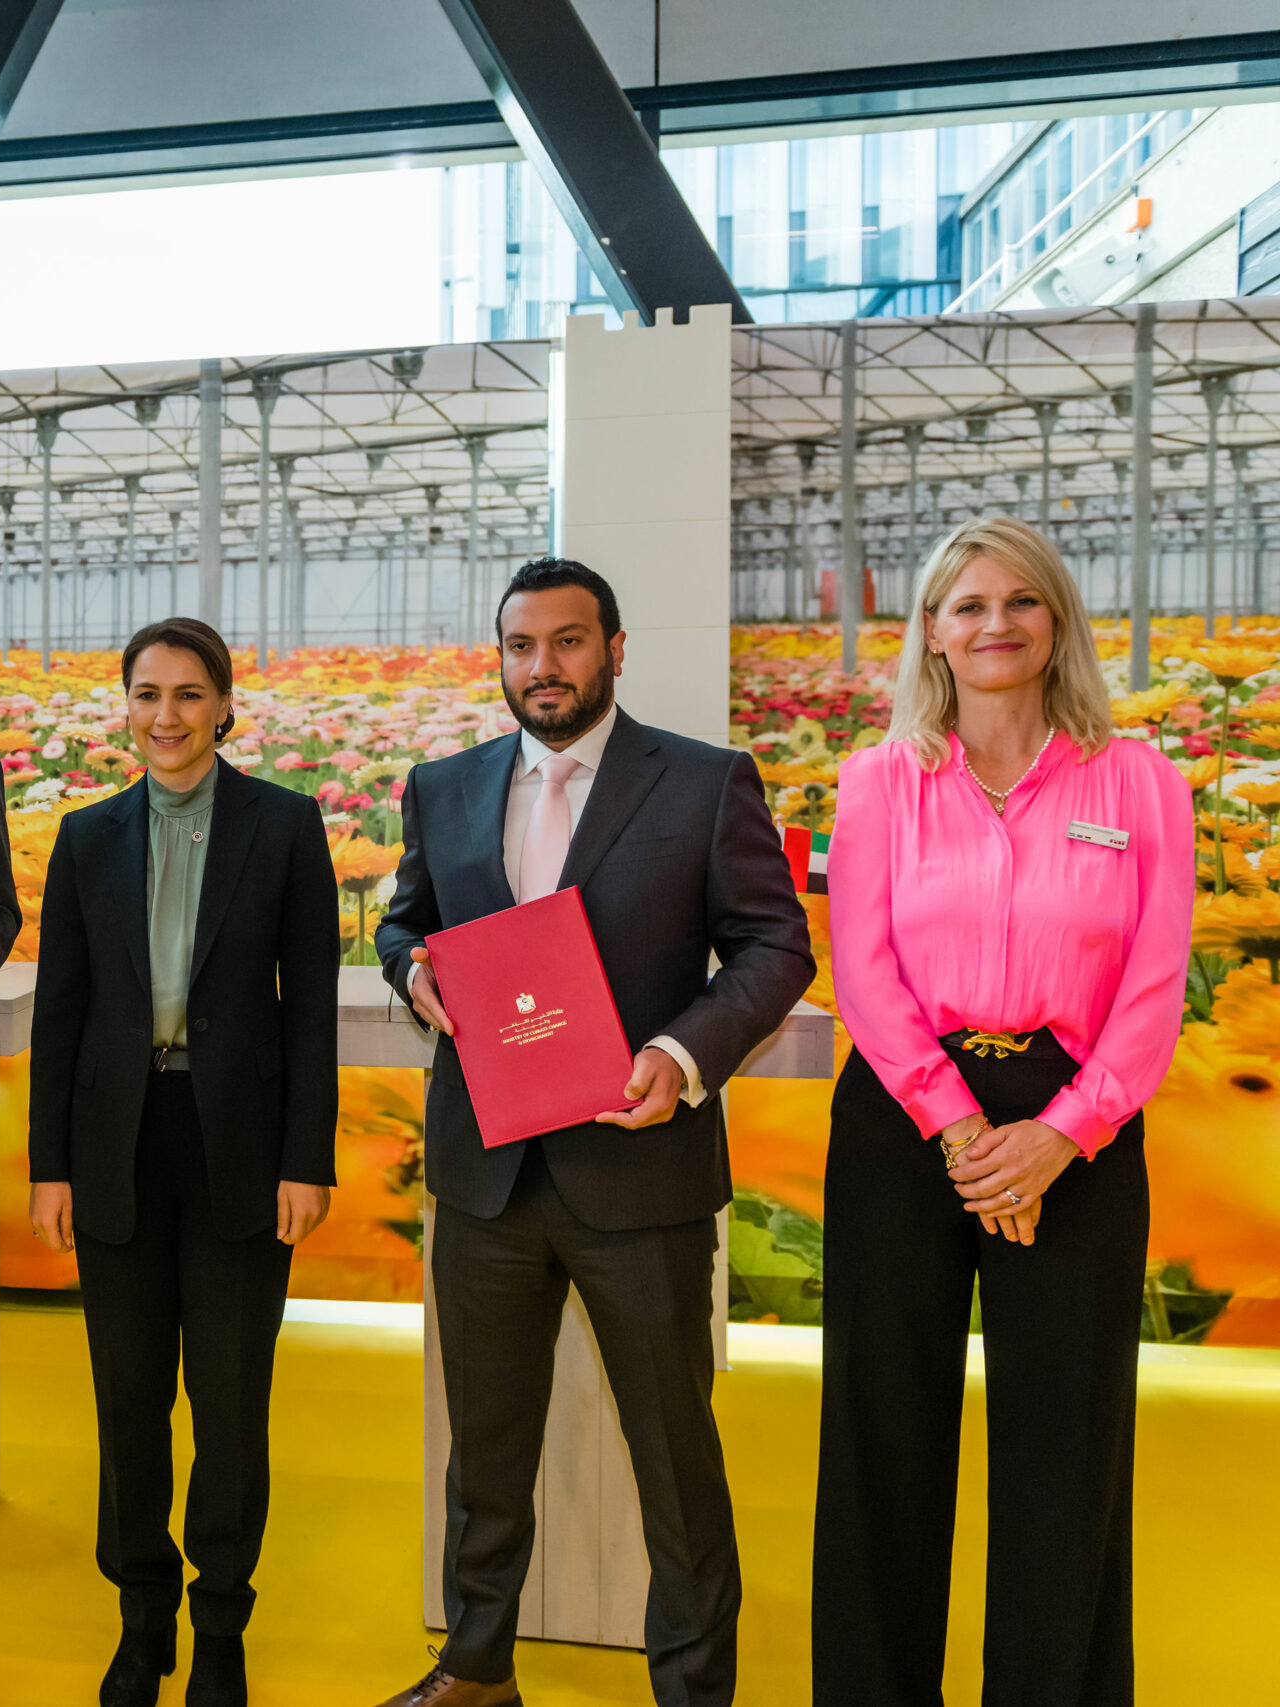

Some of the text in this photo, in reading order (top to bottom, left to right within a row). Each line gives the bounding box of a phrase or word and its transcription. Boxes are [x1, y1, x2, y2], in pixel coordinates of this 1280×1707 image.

[502, 1034, 522, 1045] MINISTRY
[529, 1026, 548, 1036] CLIMATE
[548, 1020, 567, 1030] CHANGE
[522, 1030, 554, 1044] ENVIRONMENT
